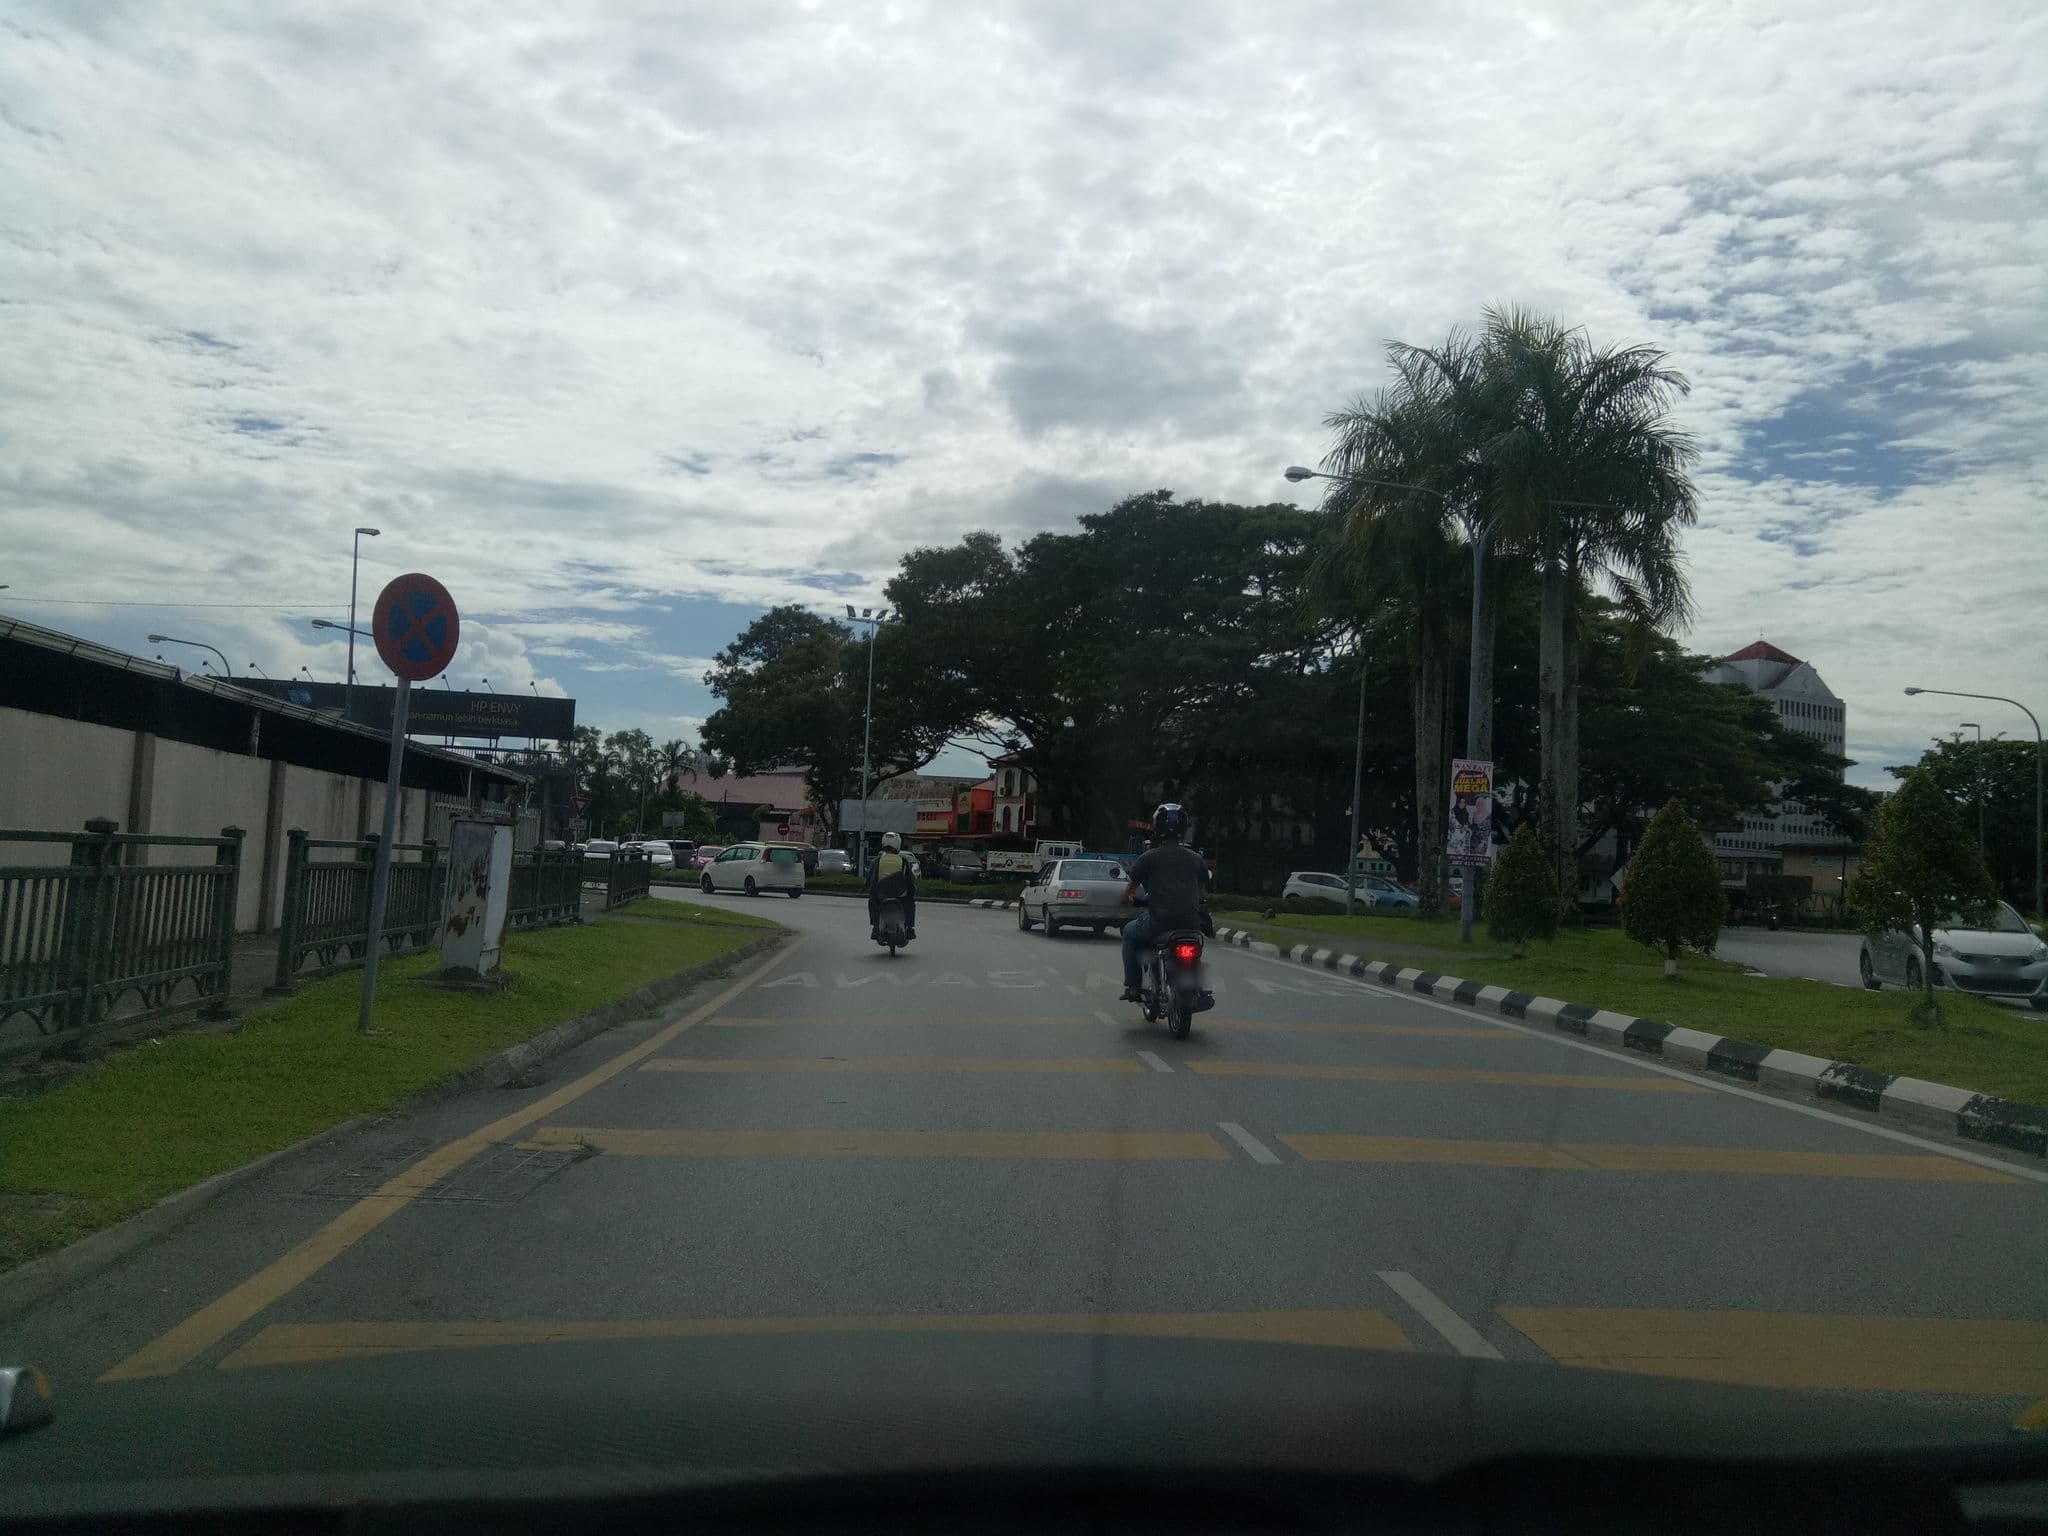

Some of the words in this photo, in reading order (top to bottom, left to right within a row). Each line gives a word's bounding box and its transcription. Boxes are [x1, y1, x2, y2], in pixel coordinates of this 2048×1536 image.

[471, 700, 488, 711] HP
[490, 702, 522, 714] ENVY
[1454, 784, 1489, 793] MEGA
